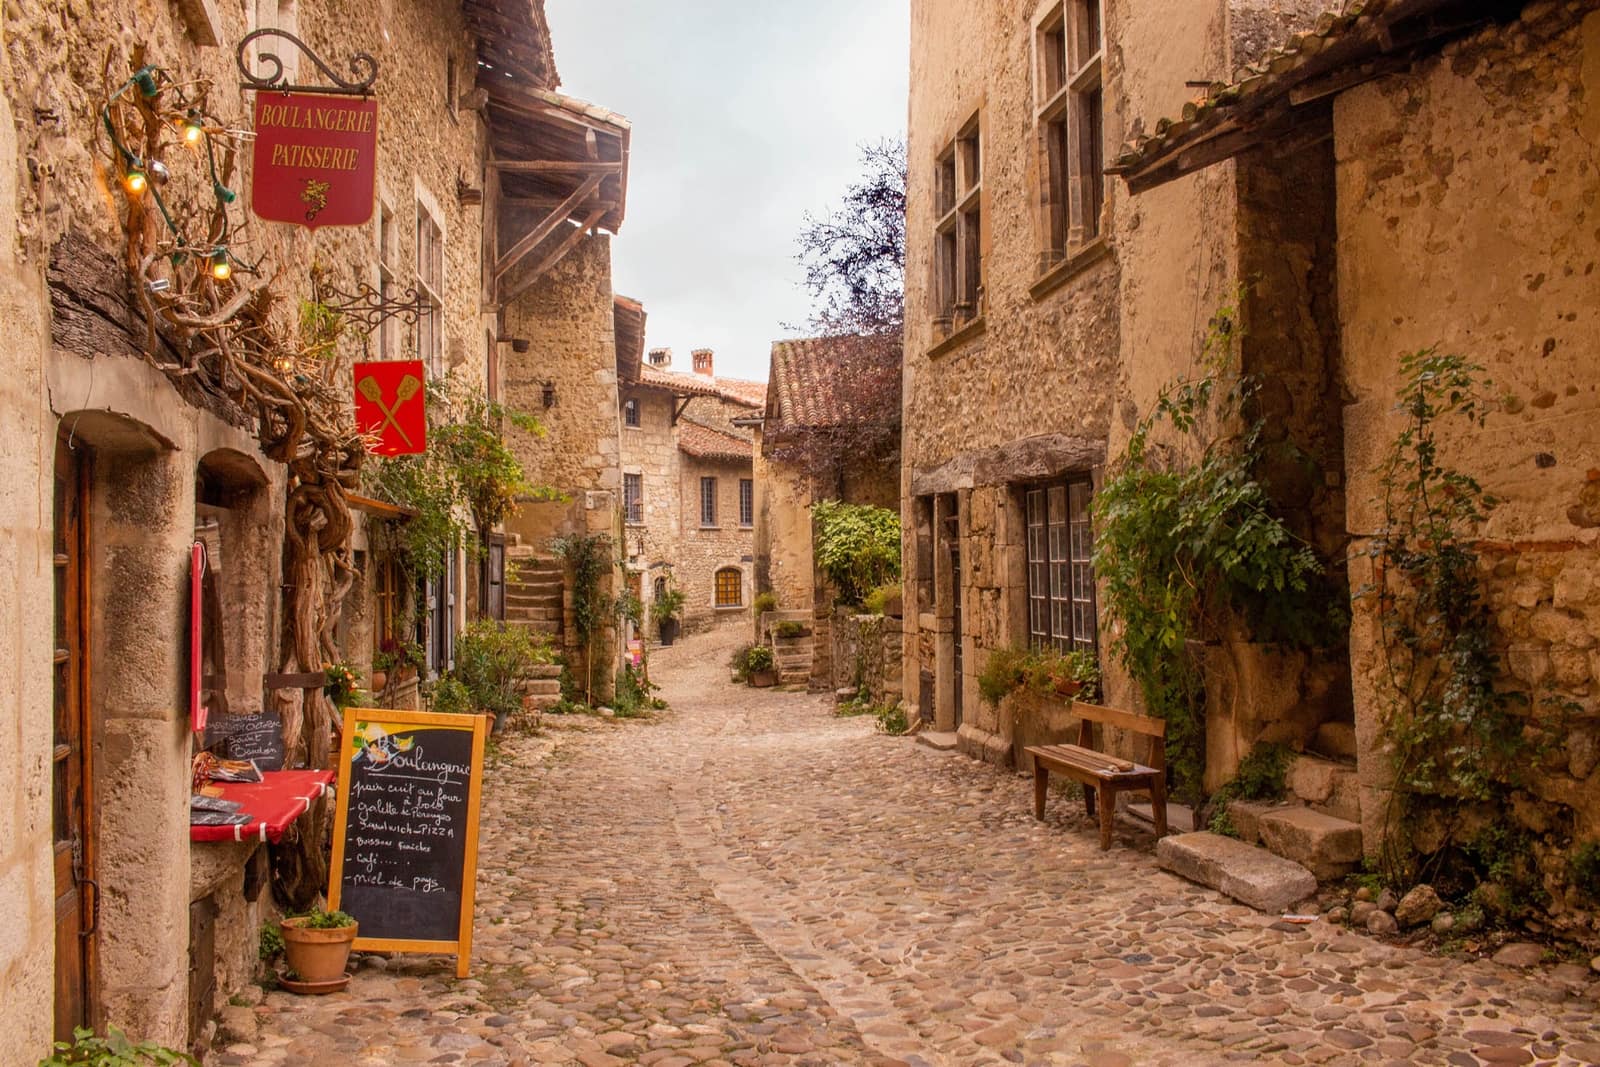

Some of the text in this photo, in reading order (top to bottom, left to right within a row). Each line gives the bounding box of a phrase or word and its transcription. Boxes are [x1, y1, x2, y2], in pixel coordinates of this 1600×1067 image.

[260, 104, 374, 133] BOULANGERIE
[271, 143, 360, 170] PATISSERIE
[363, 734, 470, 784] Boulangerie
[353, 781, 385, 799] pain
[387, 783, 414, 795] cuit
[437, 788, 462, 808] four
[388, 876, 404, 888] de
[413, 877, 439, 893] pays
